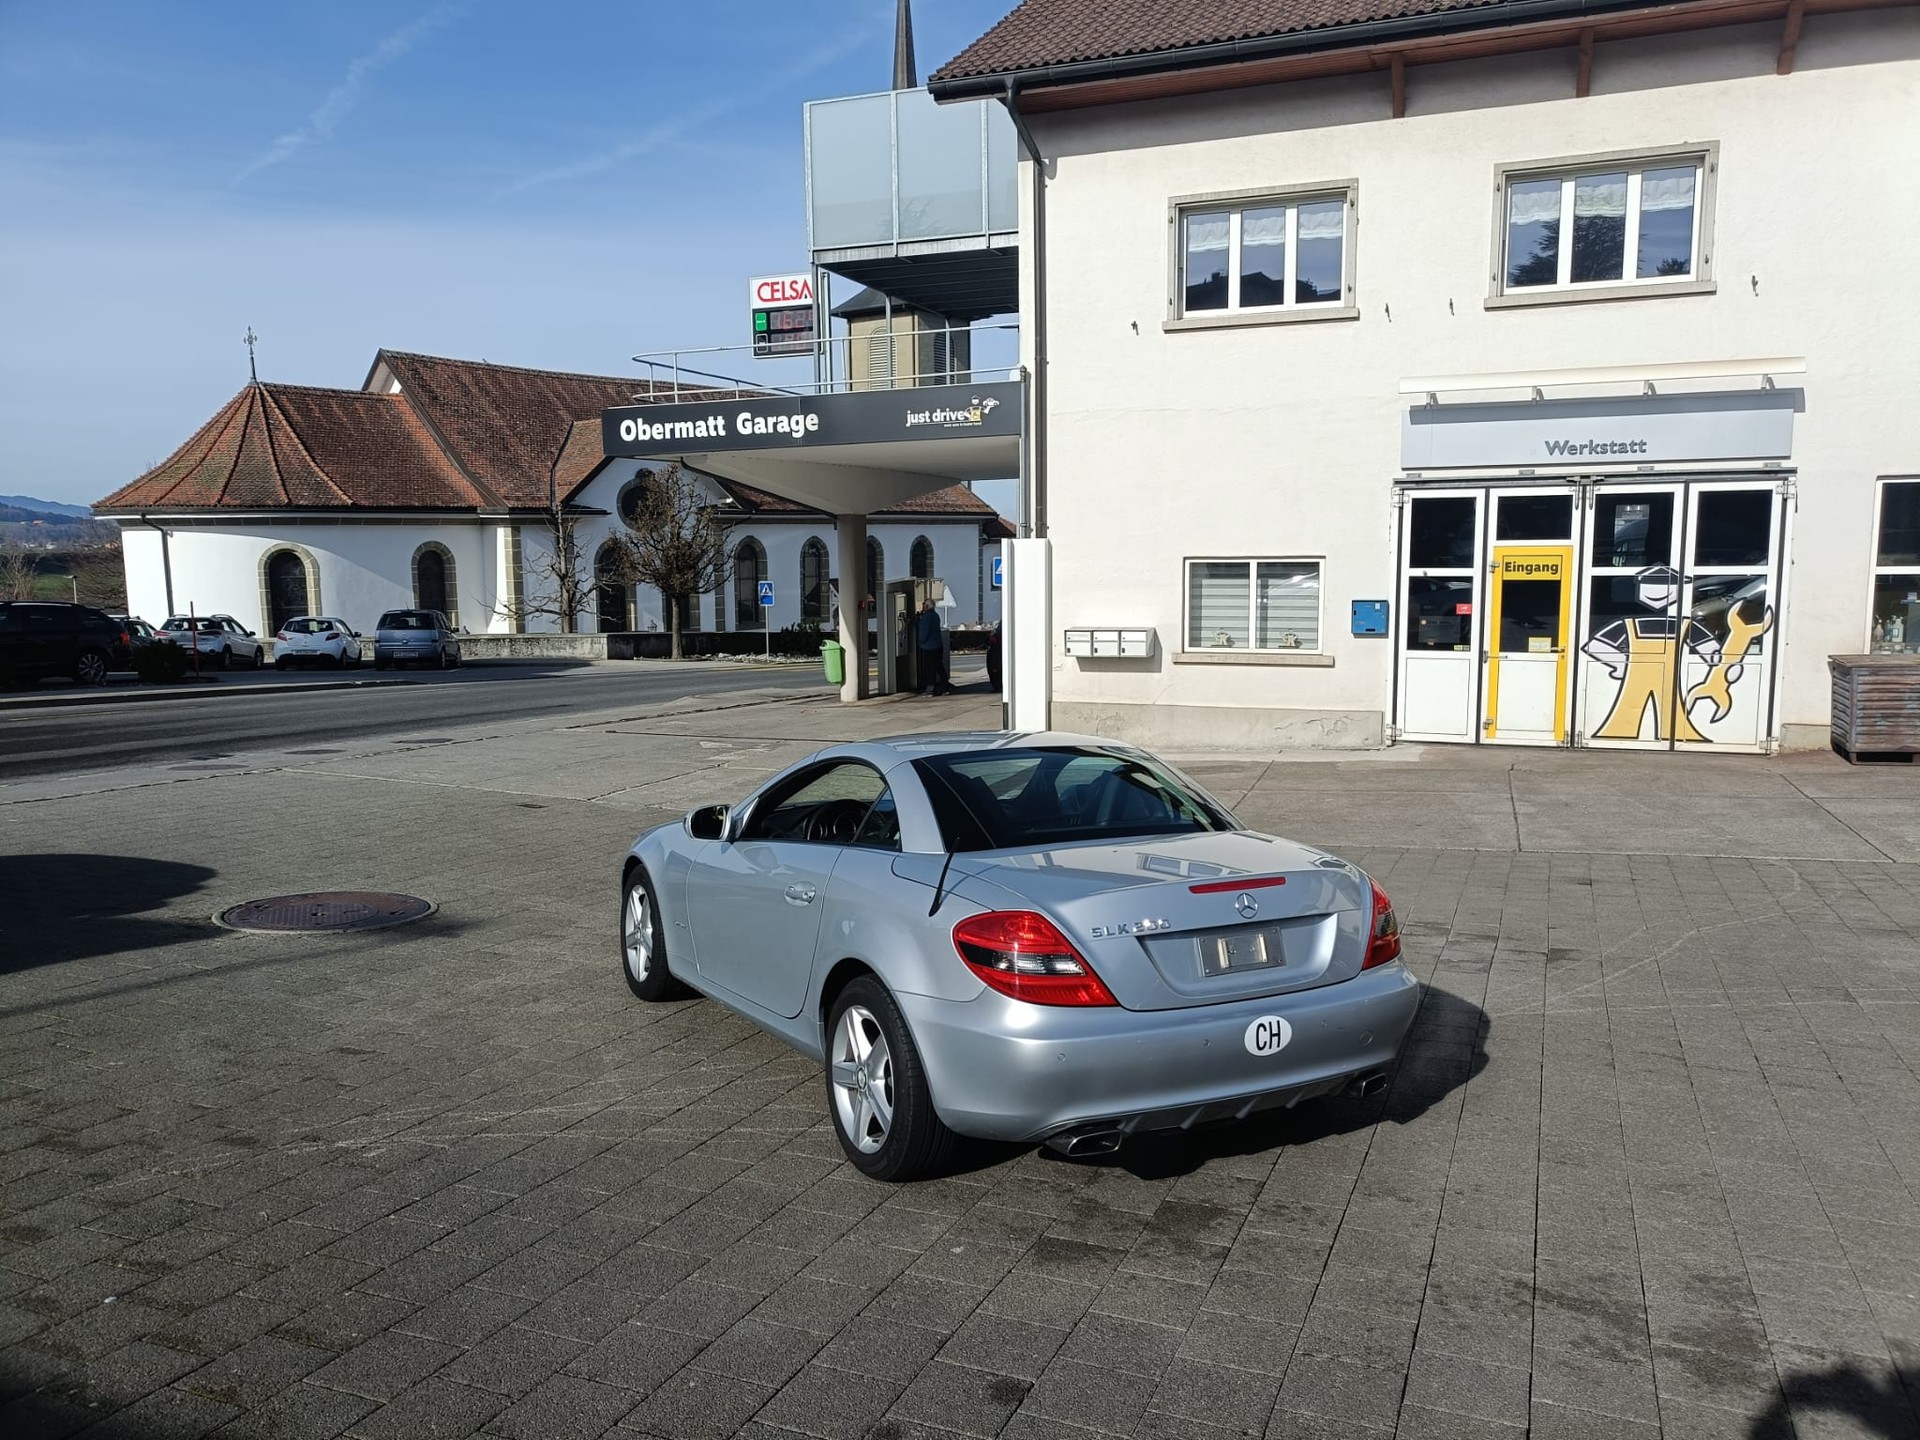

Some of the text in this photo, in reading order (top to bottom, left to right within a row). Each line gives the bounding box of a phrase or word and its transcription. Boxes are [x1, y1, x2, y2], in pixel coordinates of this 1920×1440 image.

[757, 279, 813, 302] CELSA
[619, 412, 819, 442] Obermatt Garage
[906, 408, 965, 427] just drive
[1544, 439, 1647, 456] Werkstatt
[1504, 561, 1559, 575] Eingang
[1090, 923, 1130, 938] SLK
[1255, 1020, 1281, 1051] CH
